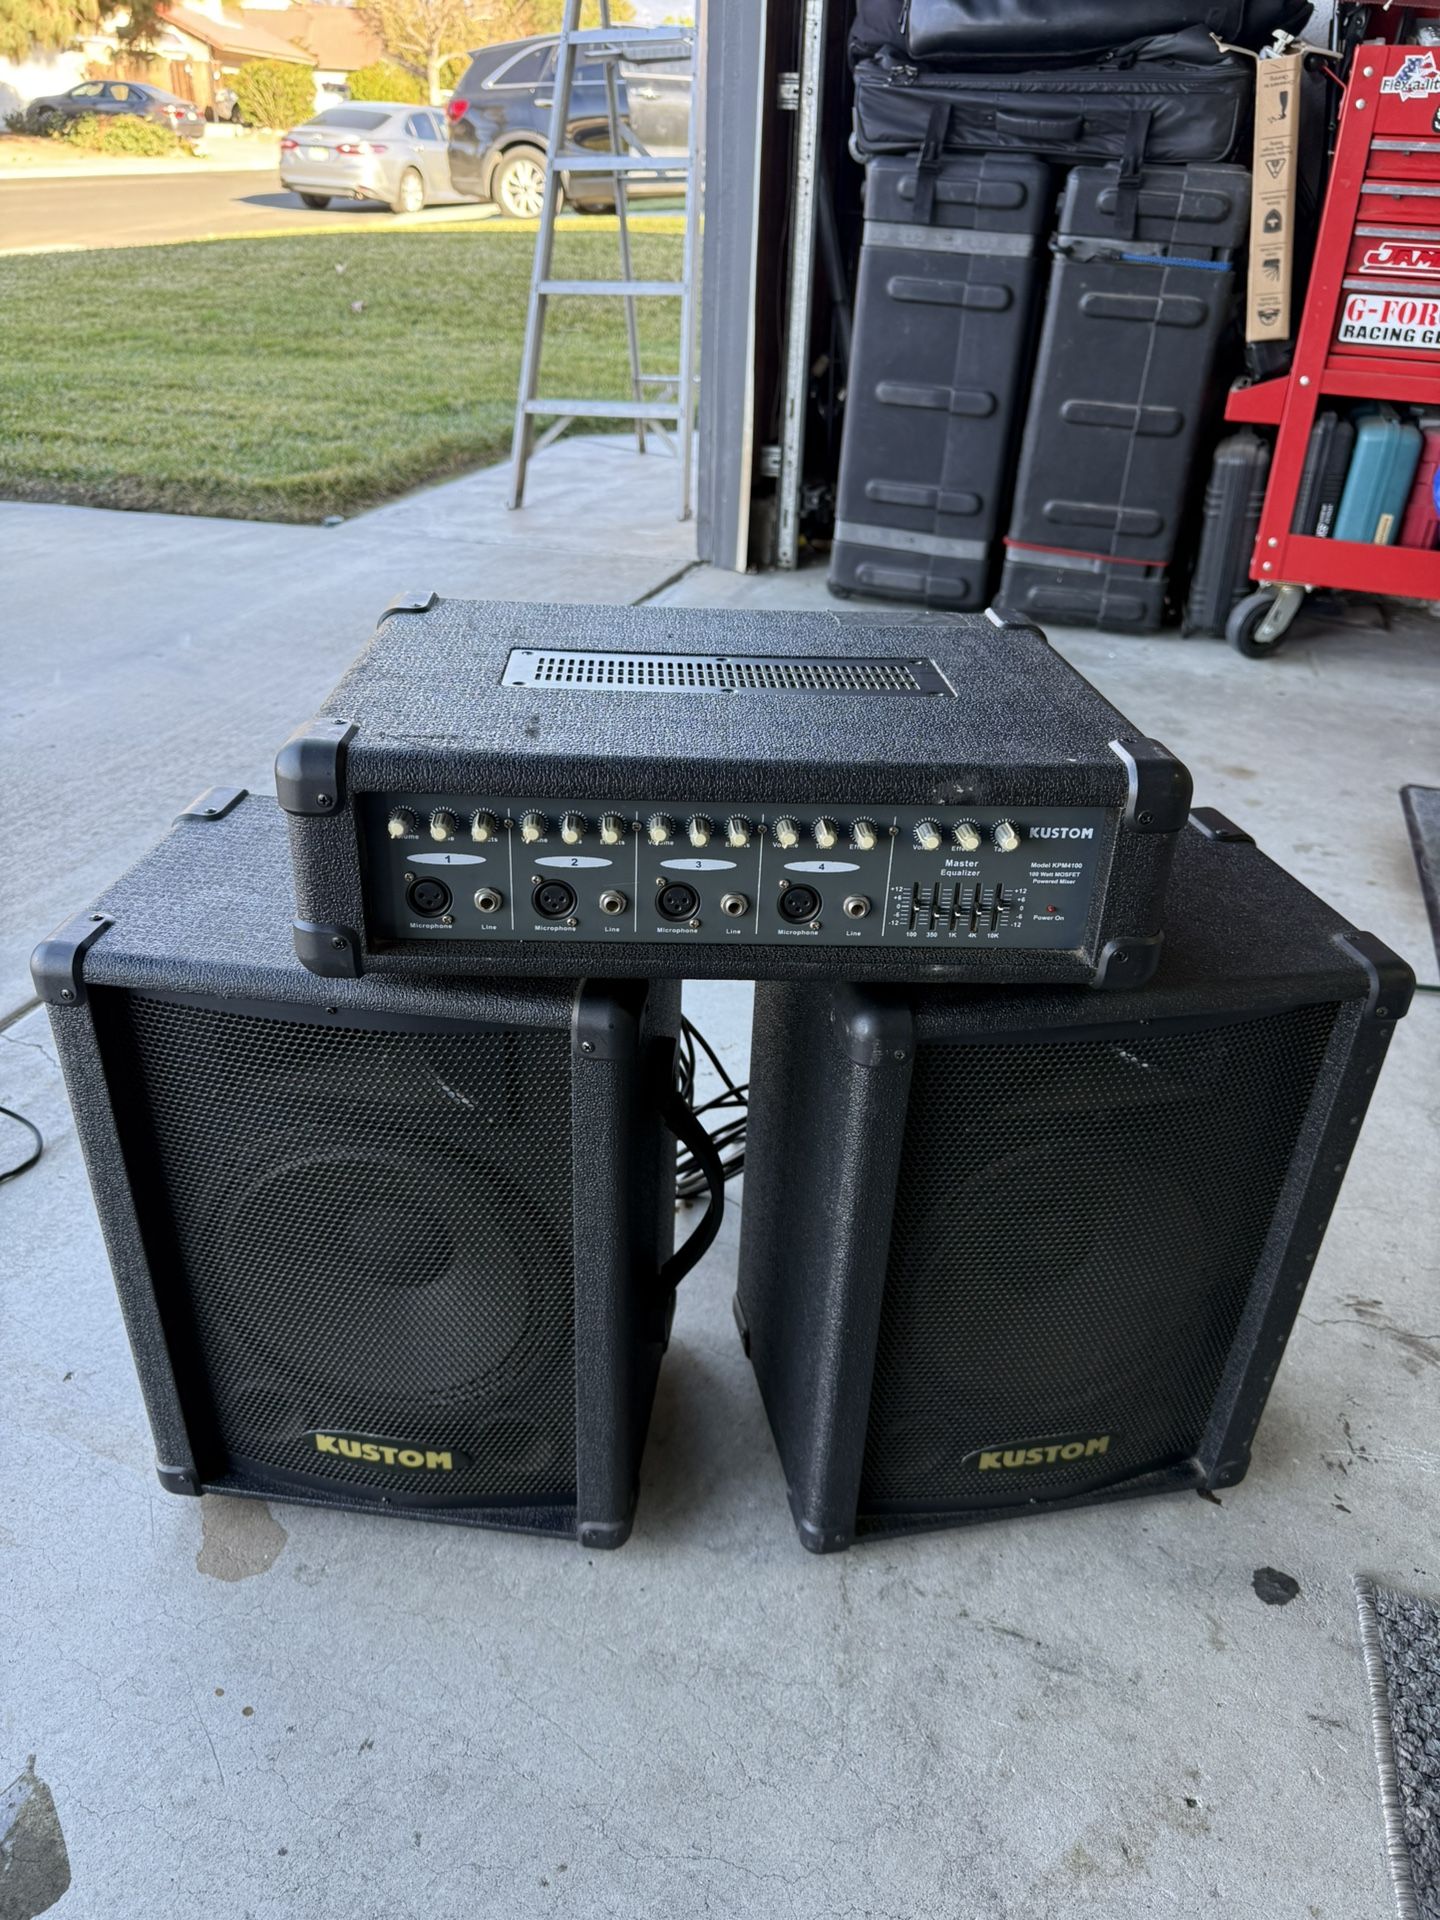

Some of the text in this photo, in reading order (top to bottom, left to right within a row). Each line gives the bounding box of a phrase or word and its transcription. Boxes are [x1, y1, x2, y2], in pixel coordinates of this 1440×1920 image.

[1347, 298, 1440, 327] G-FOR
[1343, 325, 1416, 342] RACING
[1029, 827, 1094, 839] KUSTOM
[444, 855, 451, 864] 1
[570, 858, 578, 866] 2
[945, 859, 979, 867] Master
[695, 861, 702, 869] 3
[818, 863, 825, 871] 4
[940, 869, 981, 877] Equalizer
[409, 922, 453, 930] Microphone
[534, 925, 577, 933] Microphone
[656, 927, 699, 935] Microphone
[316, 1434, 452, 1470] KUSTOM
[979, 1436, 1109, 1470] KUSTOM
